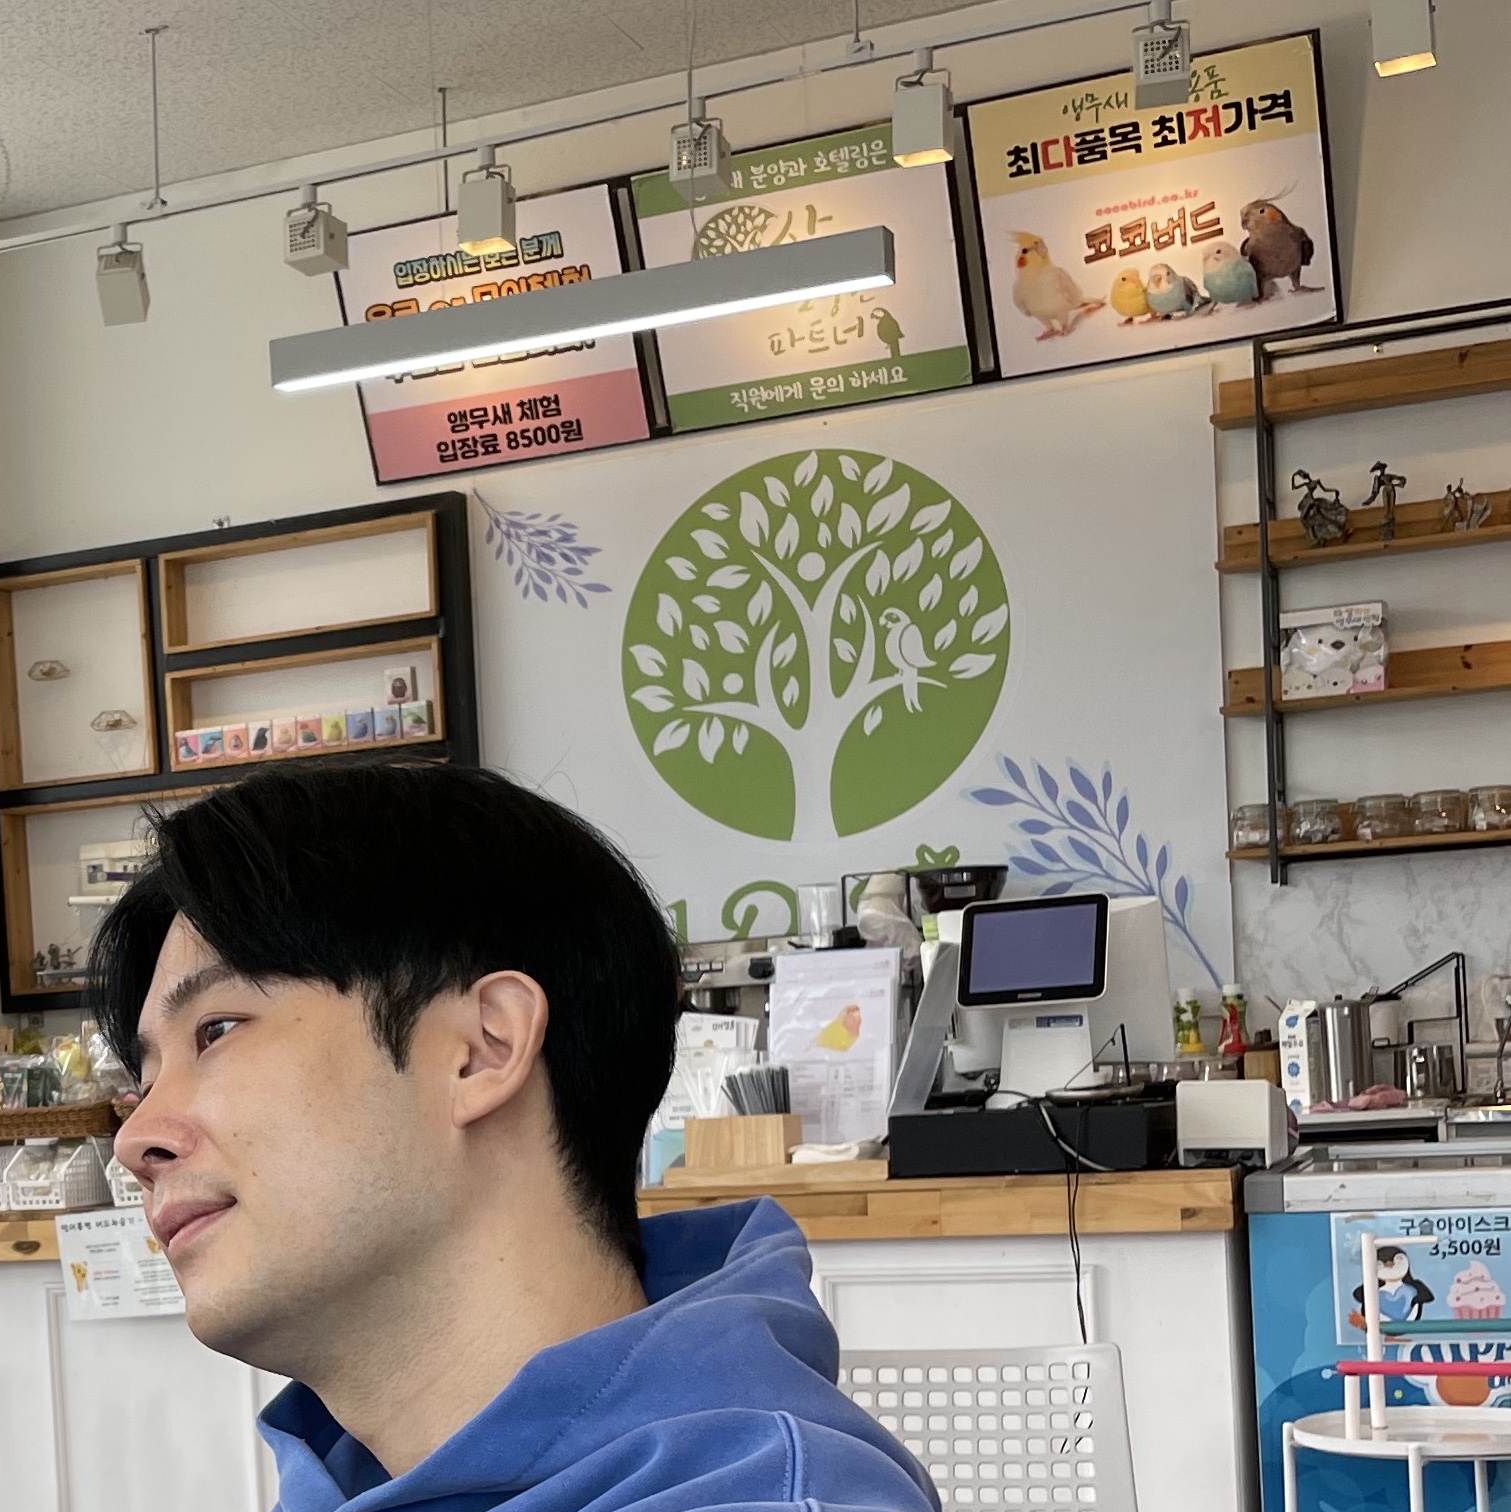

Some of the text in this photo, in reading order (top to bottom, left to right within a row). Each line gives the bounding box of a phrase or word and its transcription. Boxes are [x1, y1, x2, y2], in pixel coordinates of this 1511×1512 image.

[1062, 92, 1129, 123] 앵무새
[1006, 89, 1294, 179] 최다품목 최저가격
[749, 157, 808, 190] 분양과
[813, 139, 888, 174] 호텔링은
[519, 230, 564, 264] 분께
[1083, 201, 1225, 264] 코코버드
[767, 315, 865, 356] 파트너
[730, 365, 909, 413] 직원에게 문의 하세요
[447, 393, 563, 434] 앵무새 체험
[436, 418, 585, 464] 입장료 8500원
[1399, 1215, 1511, 1237] 구슬아이스크
[1429, 1237, 1502, 1260] 3,500원
